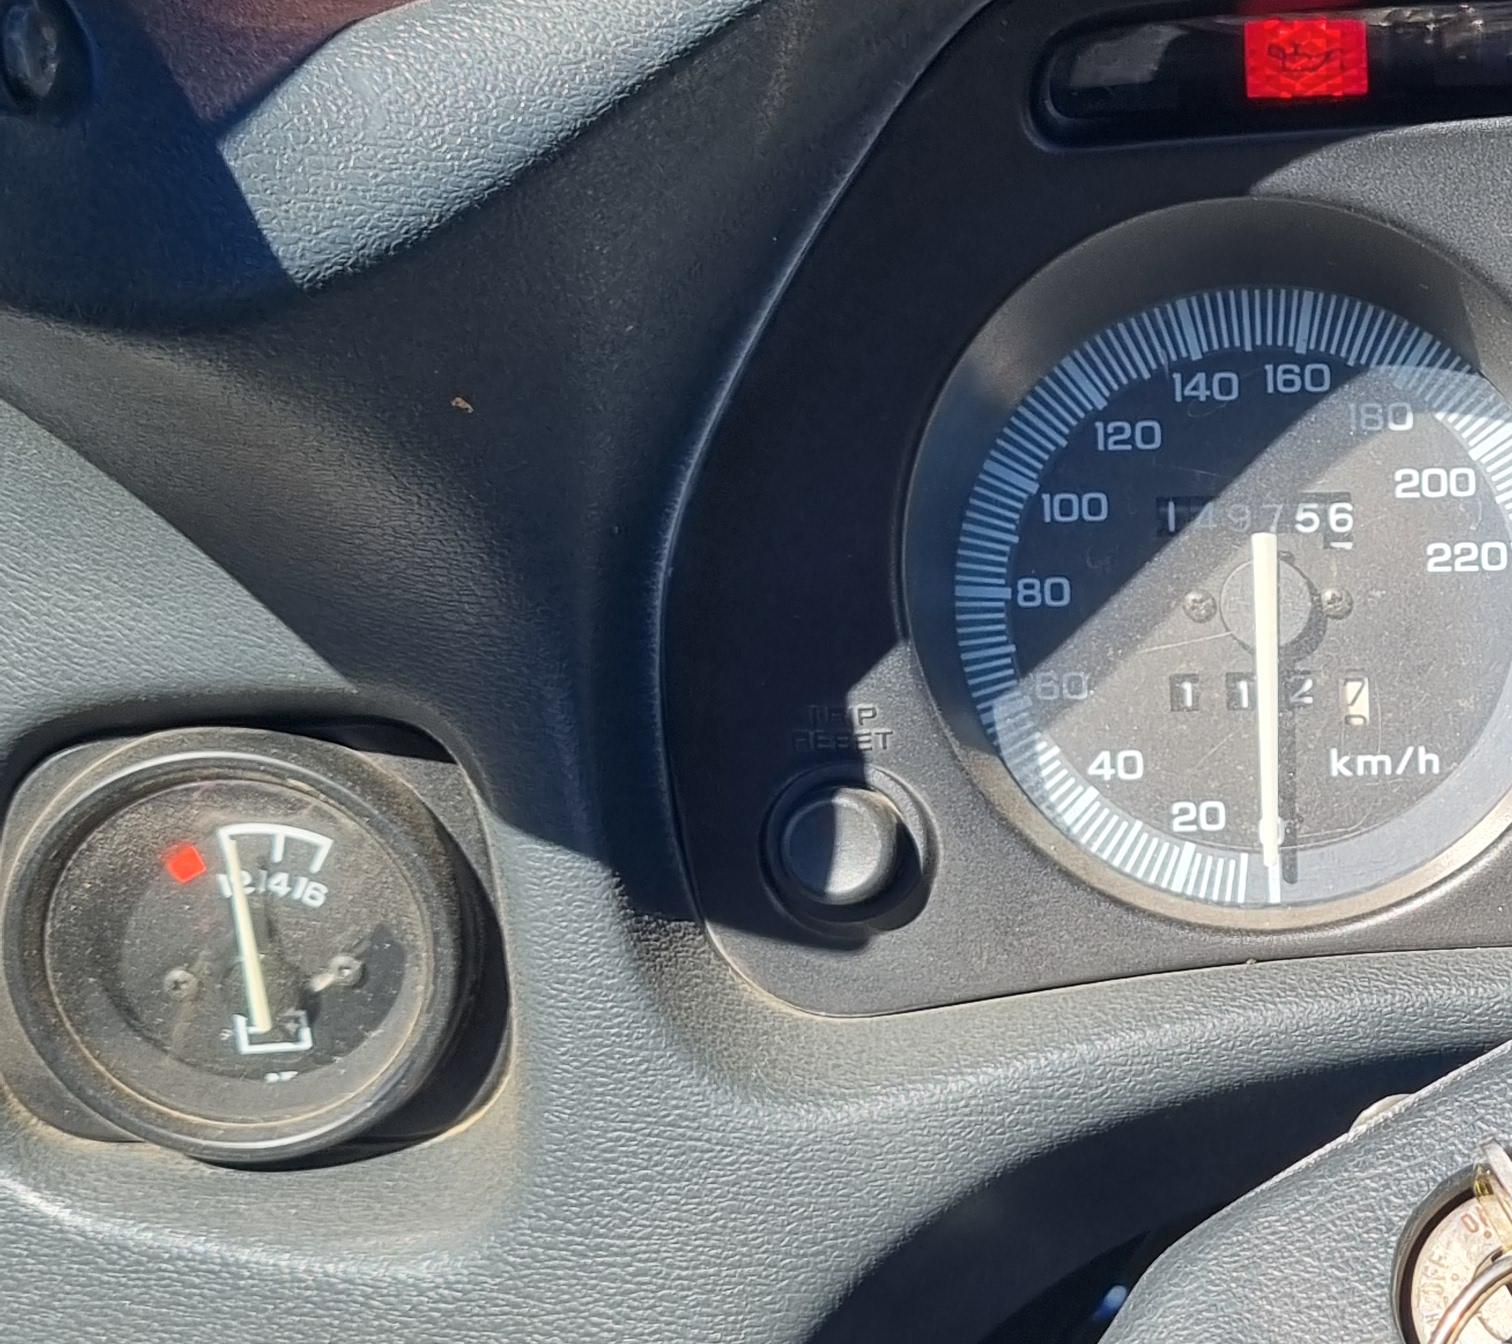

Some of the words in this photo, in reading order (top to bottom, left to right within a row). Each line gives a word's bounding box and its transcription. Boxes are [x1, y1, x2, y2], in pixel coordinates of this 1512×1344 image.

[1172, 372, 1239, 403] 140
[1264, 363, 1331, 394] 160
[1351, 401, 1414, 432] 180
[1095, 420, 1162, 451] 120
[1393, 467, 1476, 499] 200
[1041, 492, 1108, 524] 100
[1425, 541, 1508, 573] 220
[1016, 576, 1071, 607] 80
[1087, 748, 1144, 781] 40
[1329, 746, 1440, 778] km/h
[1171, 800, 1226, 832] 20
[292, 875, 329, 908] 16
